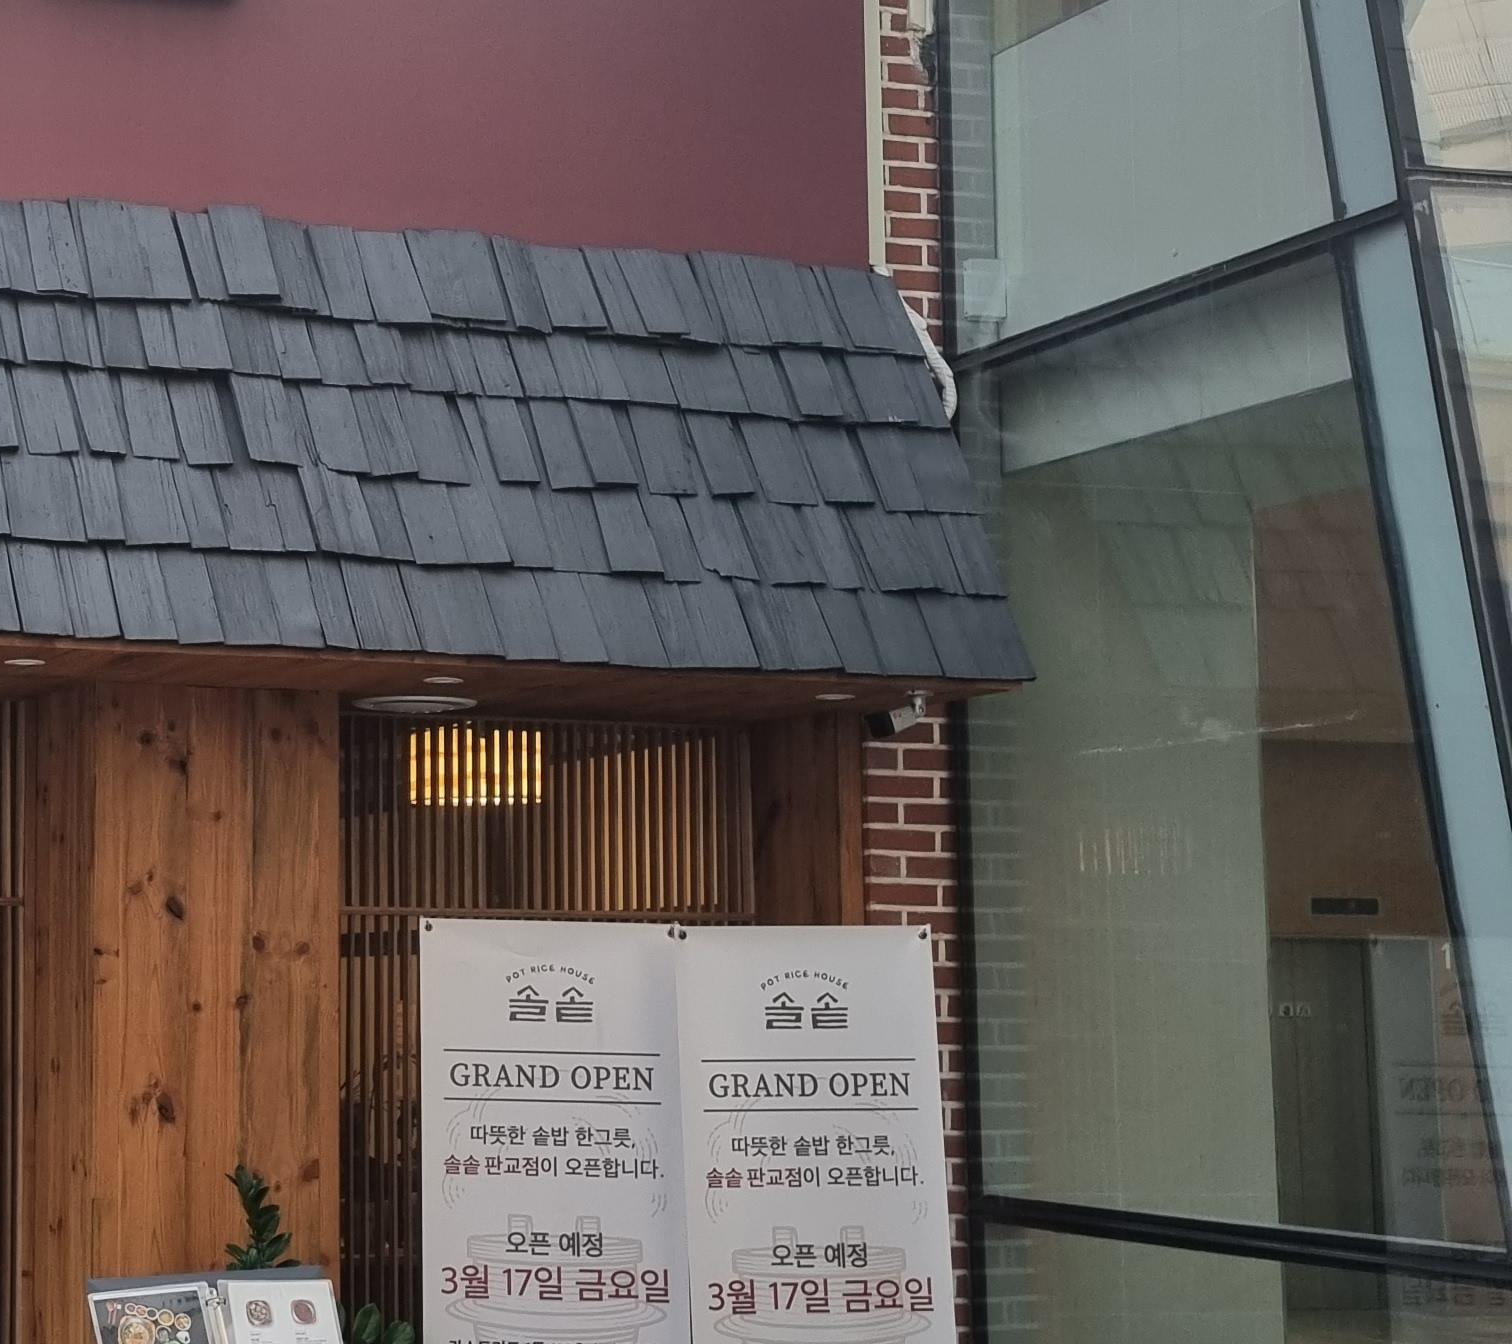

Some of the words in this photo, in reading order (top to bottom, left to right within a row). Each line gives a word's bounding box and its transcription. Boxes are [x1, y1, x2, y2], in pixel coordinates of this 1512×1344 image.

[504, 967, 526, 984] POT
[530, 964, 555, 974] RICE
[560, 965, 595, 985] HOUSE
[760, 974, 782, 991] POT
[784, 969, 810, 981] RICE
[814, 971, 850, 990] HOUSE
[509, 985, 594, 1023] 솔솥
[765, 992, 849, 1030] 솔솥
[449, 1063, 560, 1090] GRAND
[570, 1065, 655, 1091] OPEN
[708, 1073, 819, 1099] GRAND
[828, 1072, 911, 1097] OPEN
[470, 1124, 525, 1146] 따뜻한
[531, 1126, 568, 1148] 솥밥
[574, 1126, 636, 1150] 한그릇,
[731, 1135, 788, 1157] 따뜻한
[793, 1135, 830, 1156] 솥밥
[835, 1135, 896, 1157] 한그릇,
[443, 1155, 481, 1176] 솔솥
[484, 1156, 559, 1178] 판교점이
[564, 1158, 665, 1180] 오픈합니다.
[705, 1167, 742, 1188] 솔솥
[747, 1166, 821, 1188] 판교점이
[827, 1166, 925, 1187] 오픈합니다.
[504, 1231, 551, 1256] 오픈
[558, 1232, 605, 1258] 예정
[770, 1244, 817, 1268] 오픈
[824, 1242, 869, 1268] 예정
[440, 1265, 490, 1299] 3월
[503, 1266, 564, 1301] 17일
[575, 1268, 671, 1304] 금요일
[707, 1279, 757, 1315] 3월
[769, 1279, 830, 1313] 17일
[843, 1277, 935, 1313] 금요일
